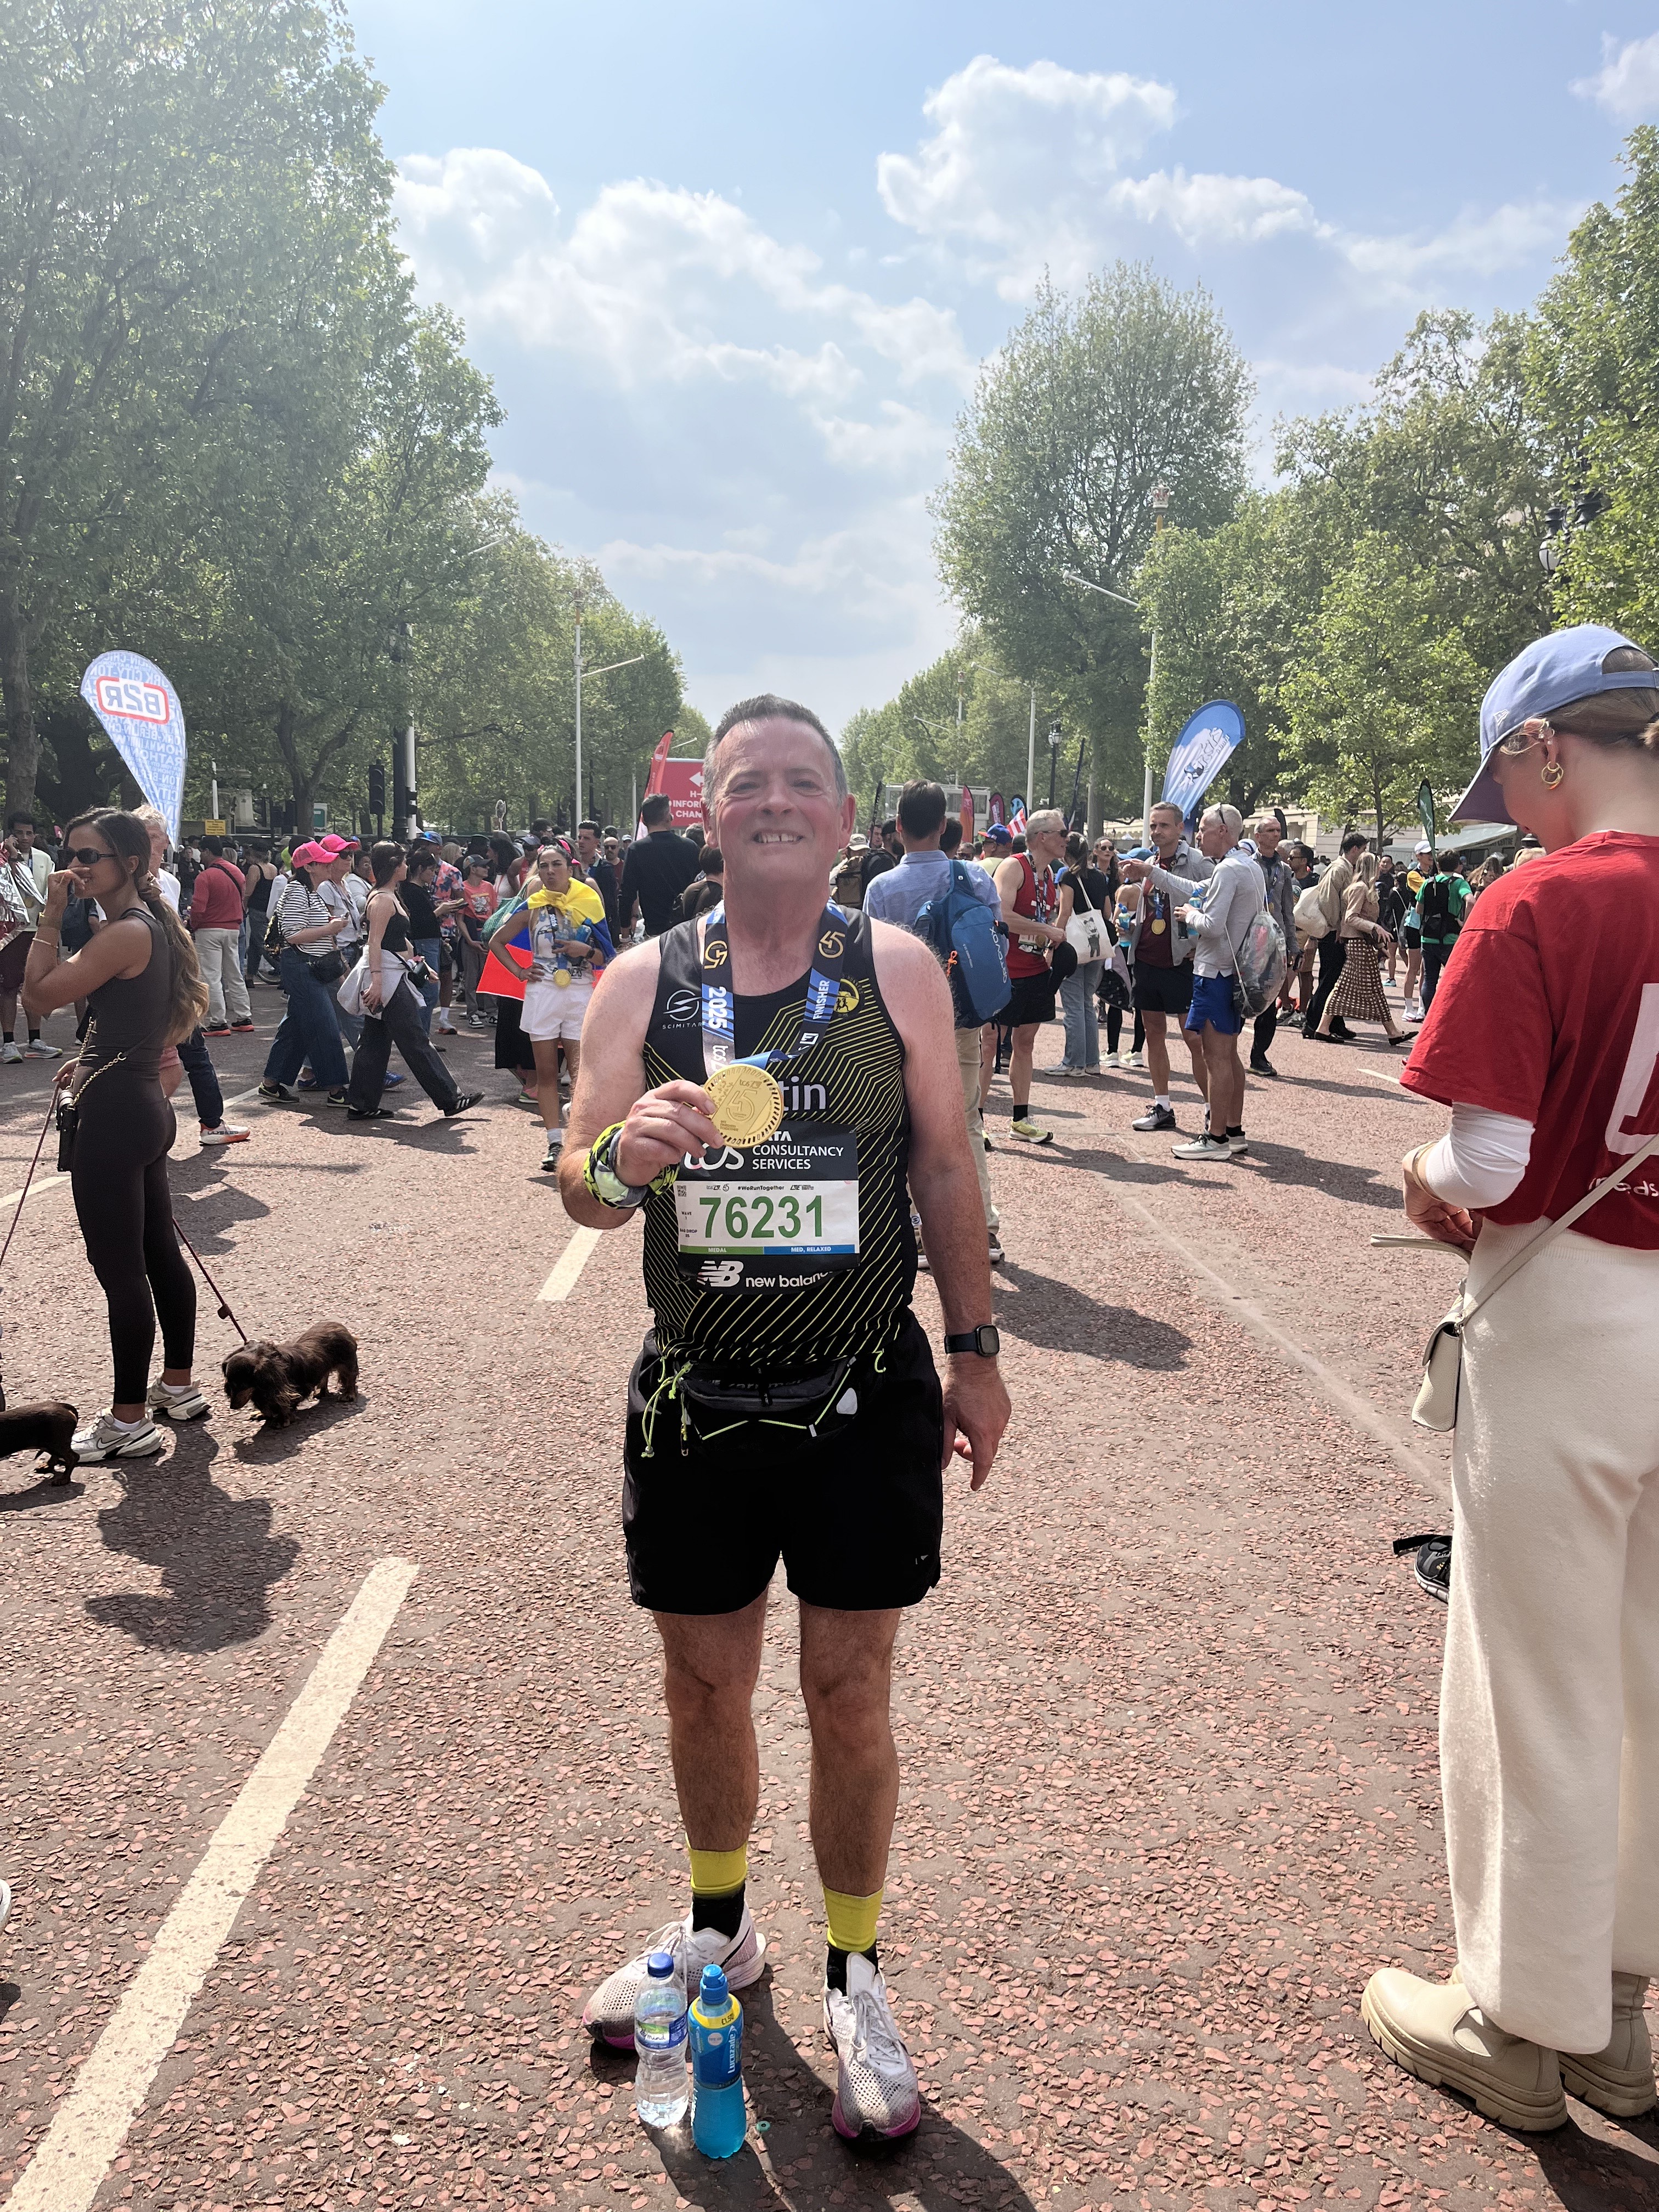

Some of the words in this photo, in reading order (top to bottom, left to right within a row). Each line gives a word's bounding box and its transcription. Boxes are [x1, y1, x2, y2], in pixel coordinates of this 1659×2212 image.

[989, 926, 1008, 984] ORTOVOX
[708, 986, 727, 1029] 2025
[812, 980, 830, 1020] FINISHER
[752, 1145, 844, 1157] CONSULTANCY
[752, 1159, 811, 1170] SERVICES
[699, 1195, 822, 1239] 76231
[746, 1277, 776, 1288] new
[727, 2033, 736, 2074] Lucozade
